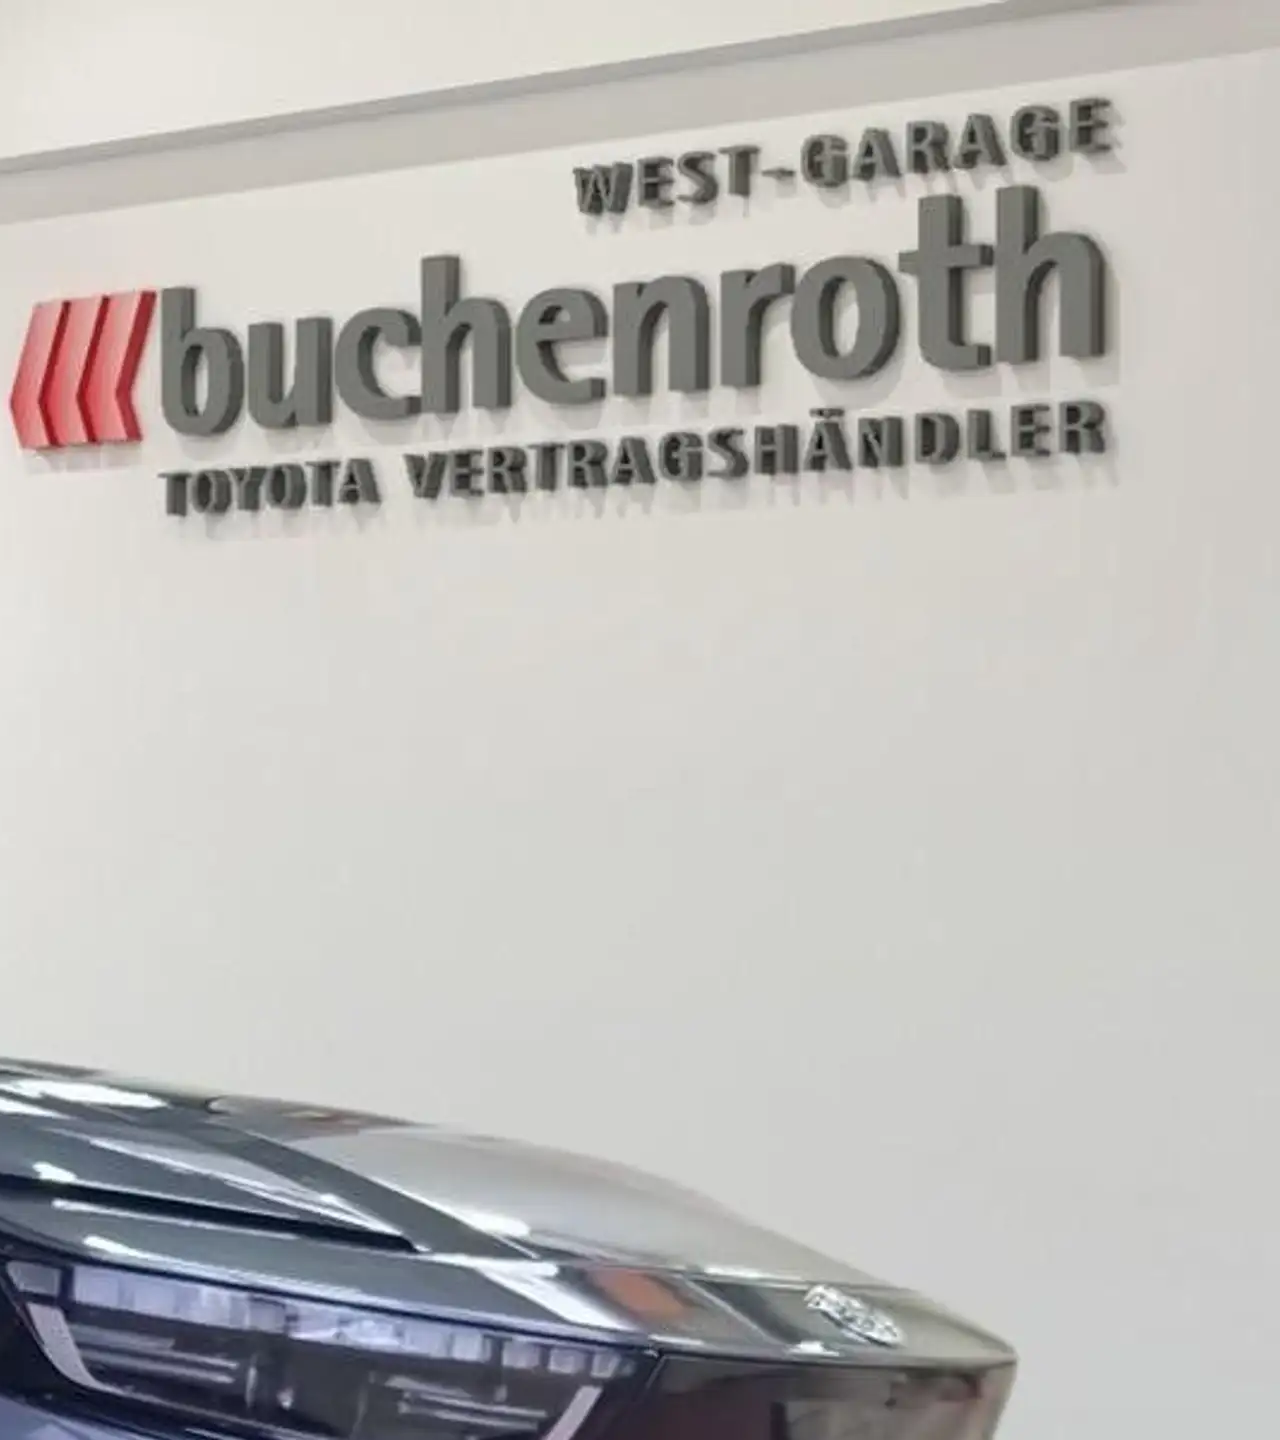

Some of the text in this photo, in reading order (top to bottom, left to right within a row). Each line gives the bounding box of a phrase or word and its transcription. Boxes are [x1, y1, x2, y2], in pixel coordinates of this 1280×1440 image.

[573, 96, 1113, 215] WEST-GARAGE
[159, 184, 1107, 437] buchenroth
[158, 399, 1109, 517] TOYOTA VERTRAGSHÄNDLER
